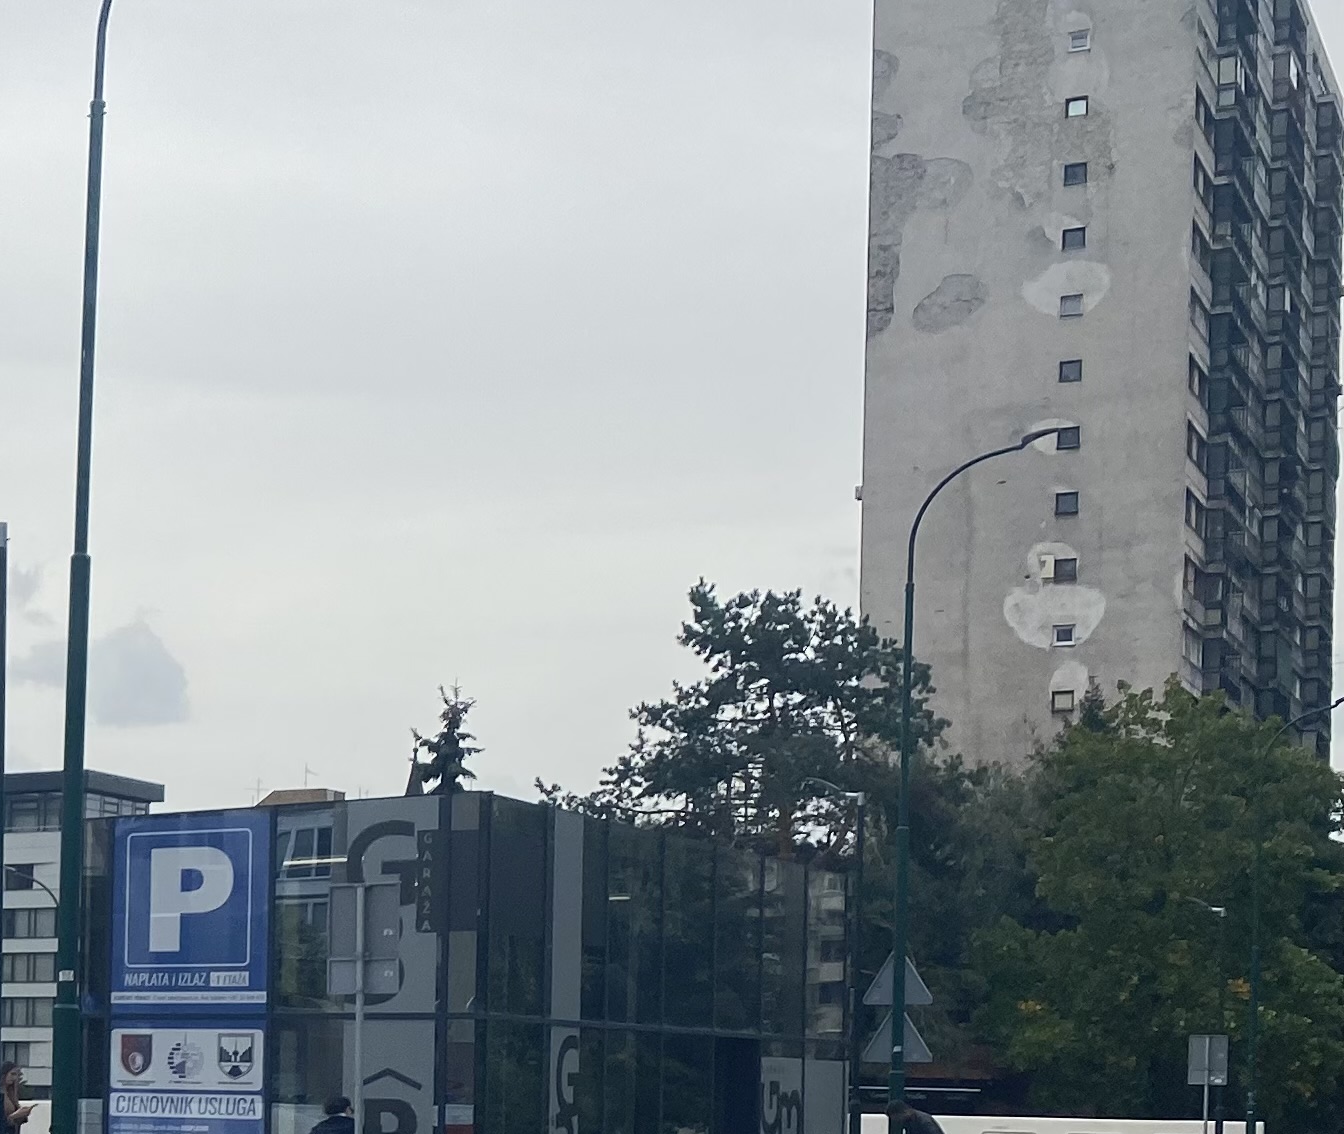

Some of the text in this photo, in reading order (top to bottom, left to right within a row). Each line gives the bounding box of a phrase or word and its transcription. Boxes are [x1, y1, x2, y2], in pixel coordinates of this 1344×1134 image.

[148, 846, 235, 953] P
[124, 972, 170, 987] NAPLATA
[171, 972, 177, 986] I
[178, 971, 207, 986] IZLAZ
[115, 1095, 257, 1117] CJENOVNIK USLUGA
